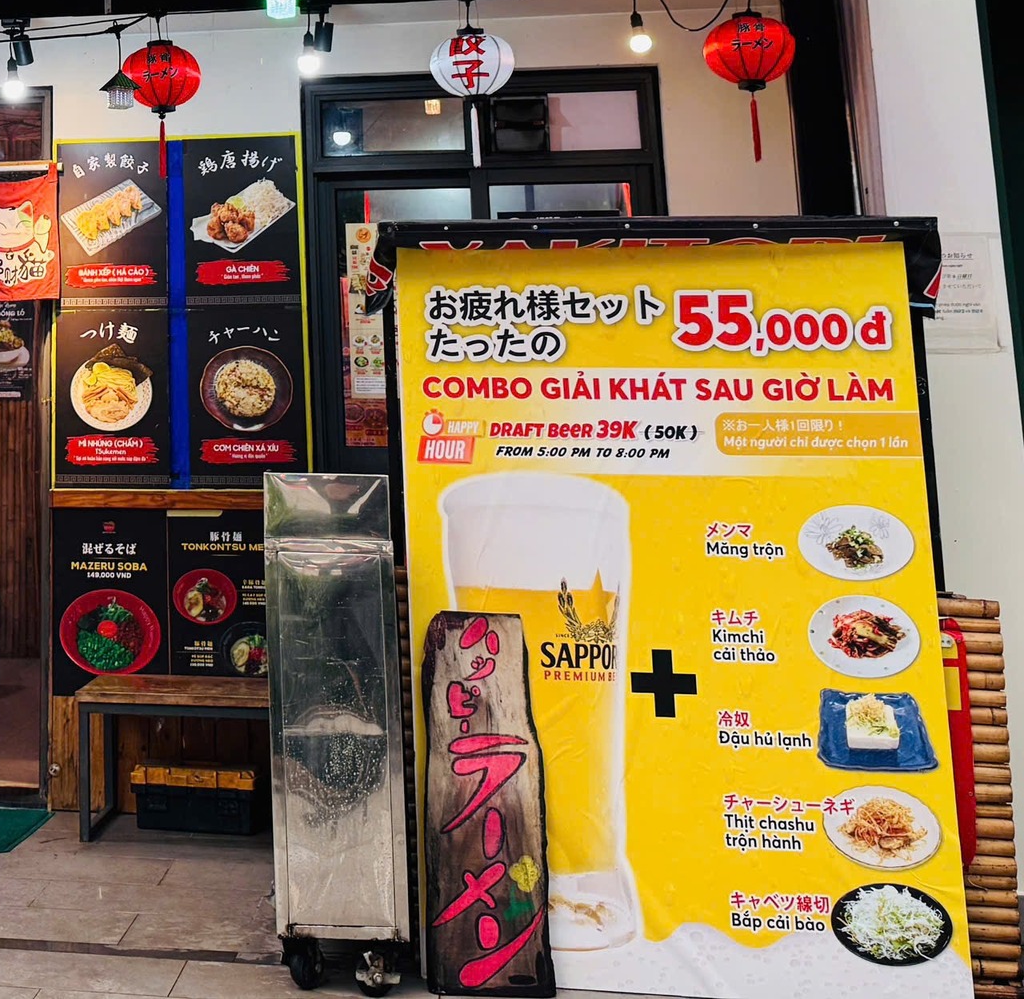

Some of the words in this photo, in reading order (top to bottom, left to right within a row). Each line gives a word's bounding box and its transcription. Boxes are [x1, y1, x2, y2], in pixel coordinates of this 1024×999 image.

[731, 39, 773, 52] ラーメン
[142, 67, 178, 83] ラーメン
[78, 267, 97, 276] BÁNH
[226, 264, 237, 273] GÀ
[429, 290, 661, 321] お疲れ様セット
[678, 294, 848, 351] 55,000
[861, 311, 887, 345] đ
[79, 322, 139, 343] つけ麺
[208, 326, 281, 344] チャーハン
[430, 328, 562, 358] たったの
[422, 376, 533, 400] COMBO
[541, 370, 600, 400] GIẢI
[609, 371, 687, 401] KHÁT
[695, 378, 753, 401] SAU
[762, 372, 821, 402] GIỜ
[827, 372, 894, 401] LÀM
[447, 421, 479, 435] HAPPY
[489, 422, 545, 438] DRAFT
[596, 419, 637, 439] 39K
[78, 439, 86, 447] MÌ
[88, 439, 113, 448] NHÚNG
[256, 443, 266, 452] XÁ
[267, 443, 279, 452] XÍU
[424, 441, 466, 460] HOUR
[724, 436, 747, 448] Một
[750, 436, 787, 450] người
[811, 436, 843, 450] được
[847, 436, 877, 450] chọn
[496, 446, 532, 457] FROM
[537, 447, 567, 457] 5:00
[571, 448, 590, 458] PM
[596, 448, 613, 458] TO
[616, 448, 645, 458] 8:00
[650, 449, 670, 459] PM
[706, 522, 752, 538] メンマ
[82, 543, 137, 555] 混ぜるそば
[181, 543, 246, 551] TONKONTSU
[706, 542, 749, 558] Măng
[753, 542, 784, 559] trộn
[70, 561, 115, 570] MAZERU
[117, 562, 148, 571] SOBA
[712, 610, 759, 626] キムチ
[712, 629, 764, 644] Kimchi
[713, 647, 736, 661] cải
[740, 647, 776, 662] thảo
[544, 670, 605, 682] PREMIUM
[718, 711, 750, 727] 冷奴
[719, 730, 749, 748] Đậu
[754, 731, 773, 747] hủ
[778, 731, 812, 750] lạnh
[432, 617, 544, 988] ハッピーラーメン
[724, 794, 856, 815] チャーシューネギ
[724, 814, 754, 832] Thịt
[759, 816, 815, 831] chashu
[726, 834, 758, 851] trộn
[762, 834, 802, 849] hành
[730, 891, 830, 913] キャベツ線切
[731, 912, 762, 931] Bắp
[767, 914, 790, 930] cải
[795, 916, 826, 932] bào
